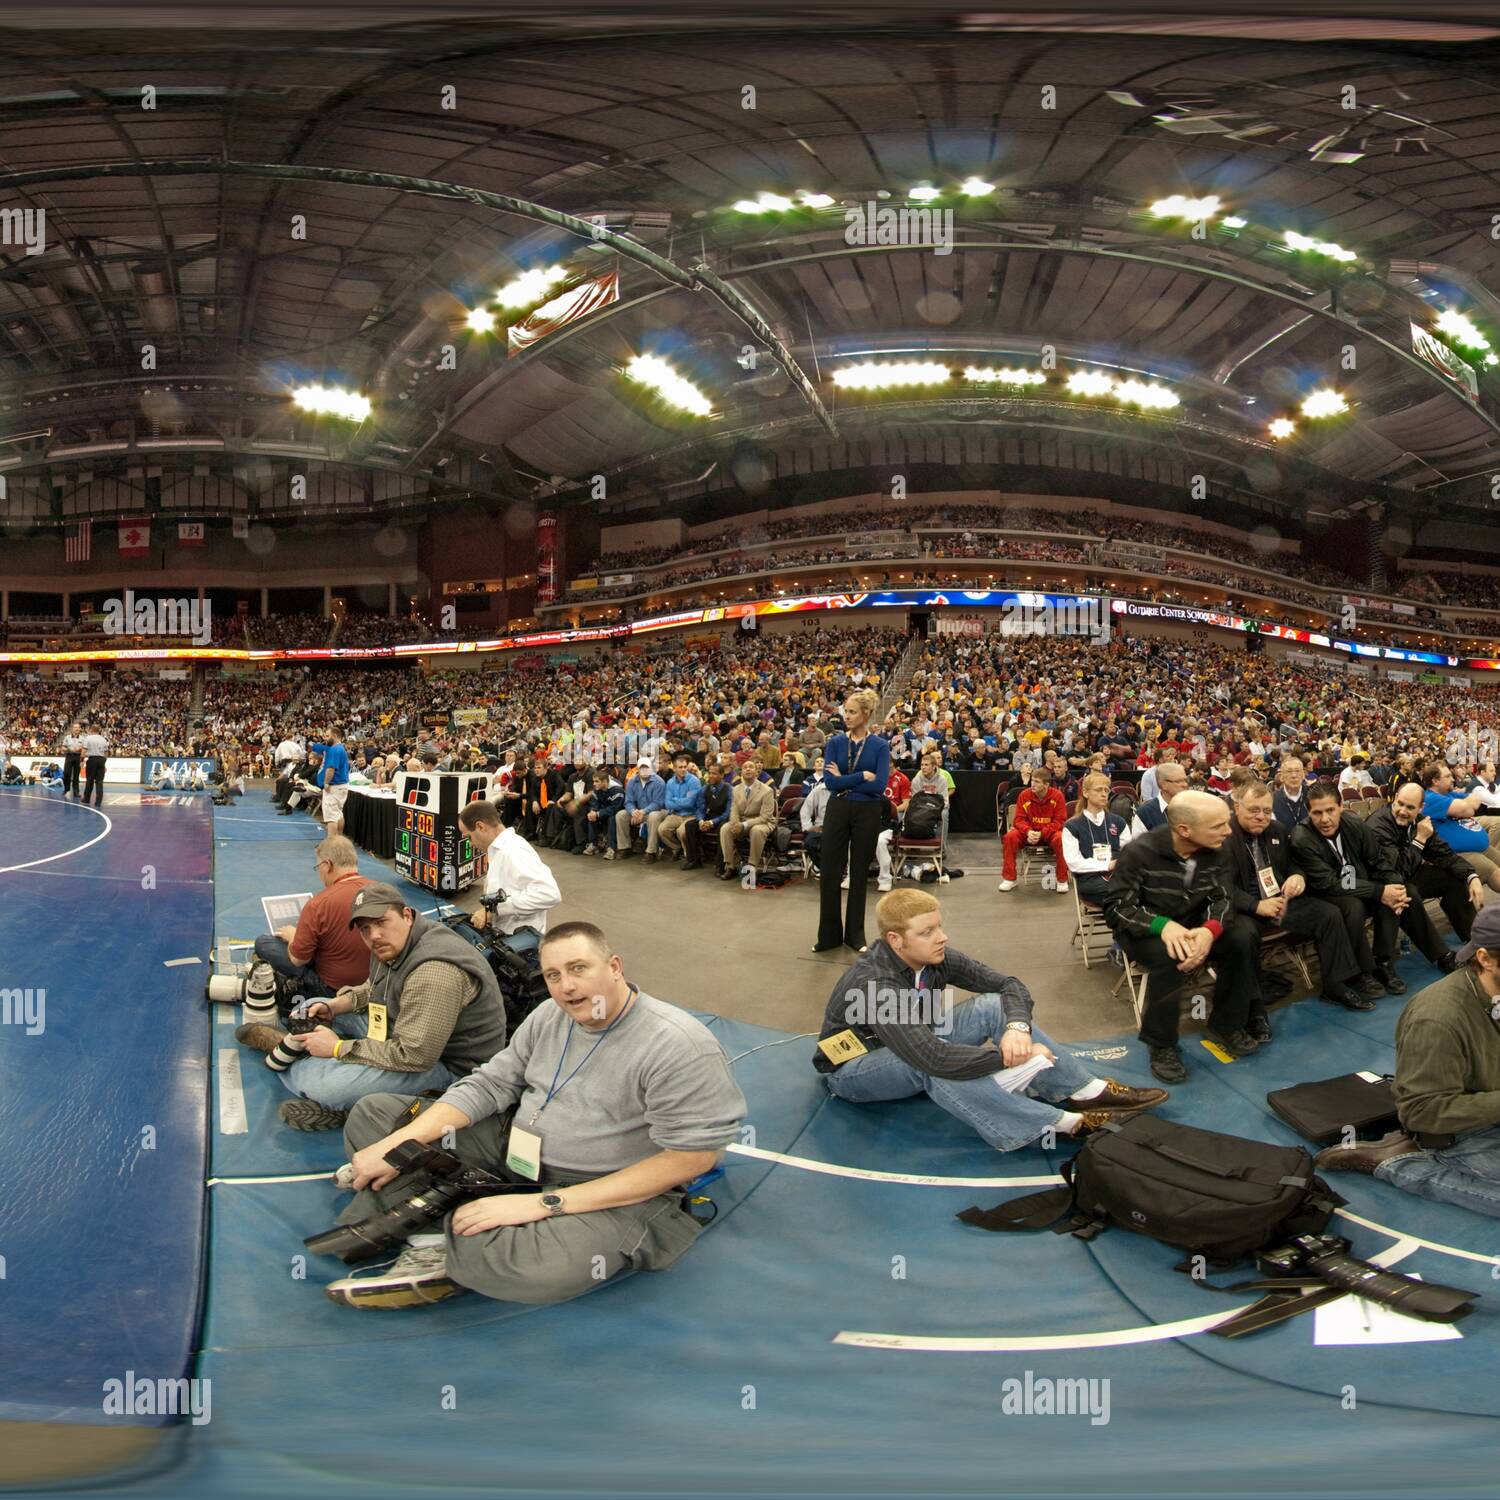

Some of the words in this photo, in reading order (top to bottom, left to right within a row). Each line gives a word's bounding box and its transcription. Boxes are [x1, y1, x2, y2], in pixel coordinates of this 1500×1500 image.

[1128, 603, 1160, 617] GUTHRIE
[1160, 606, 1186, 619] CENTER
[802, 618, 821, 627] 103
[1192, 630, 1208, 639] 105
[405, 810, 433, 837] 2:00
